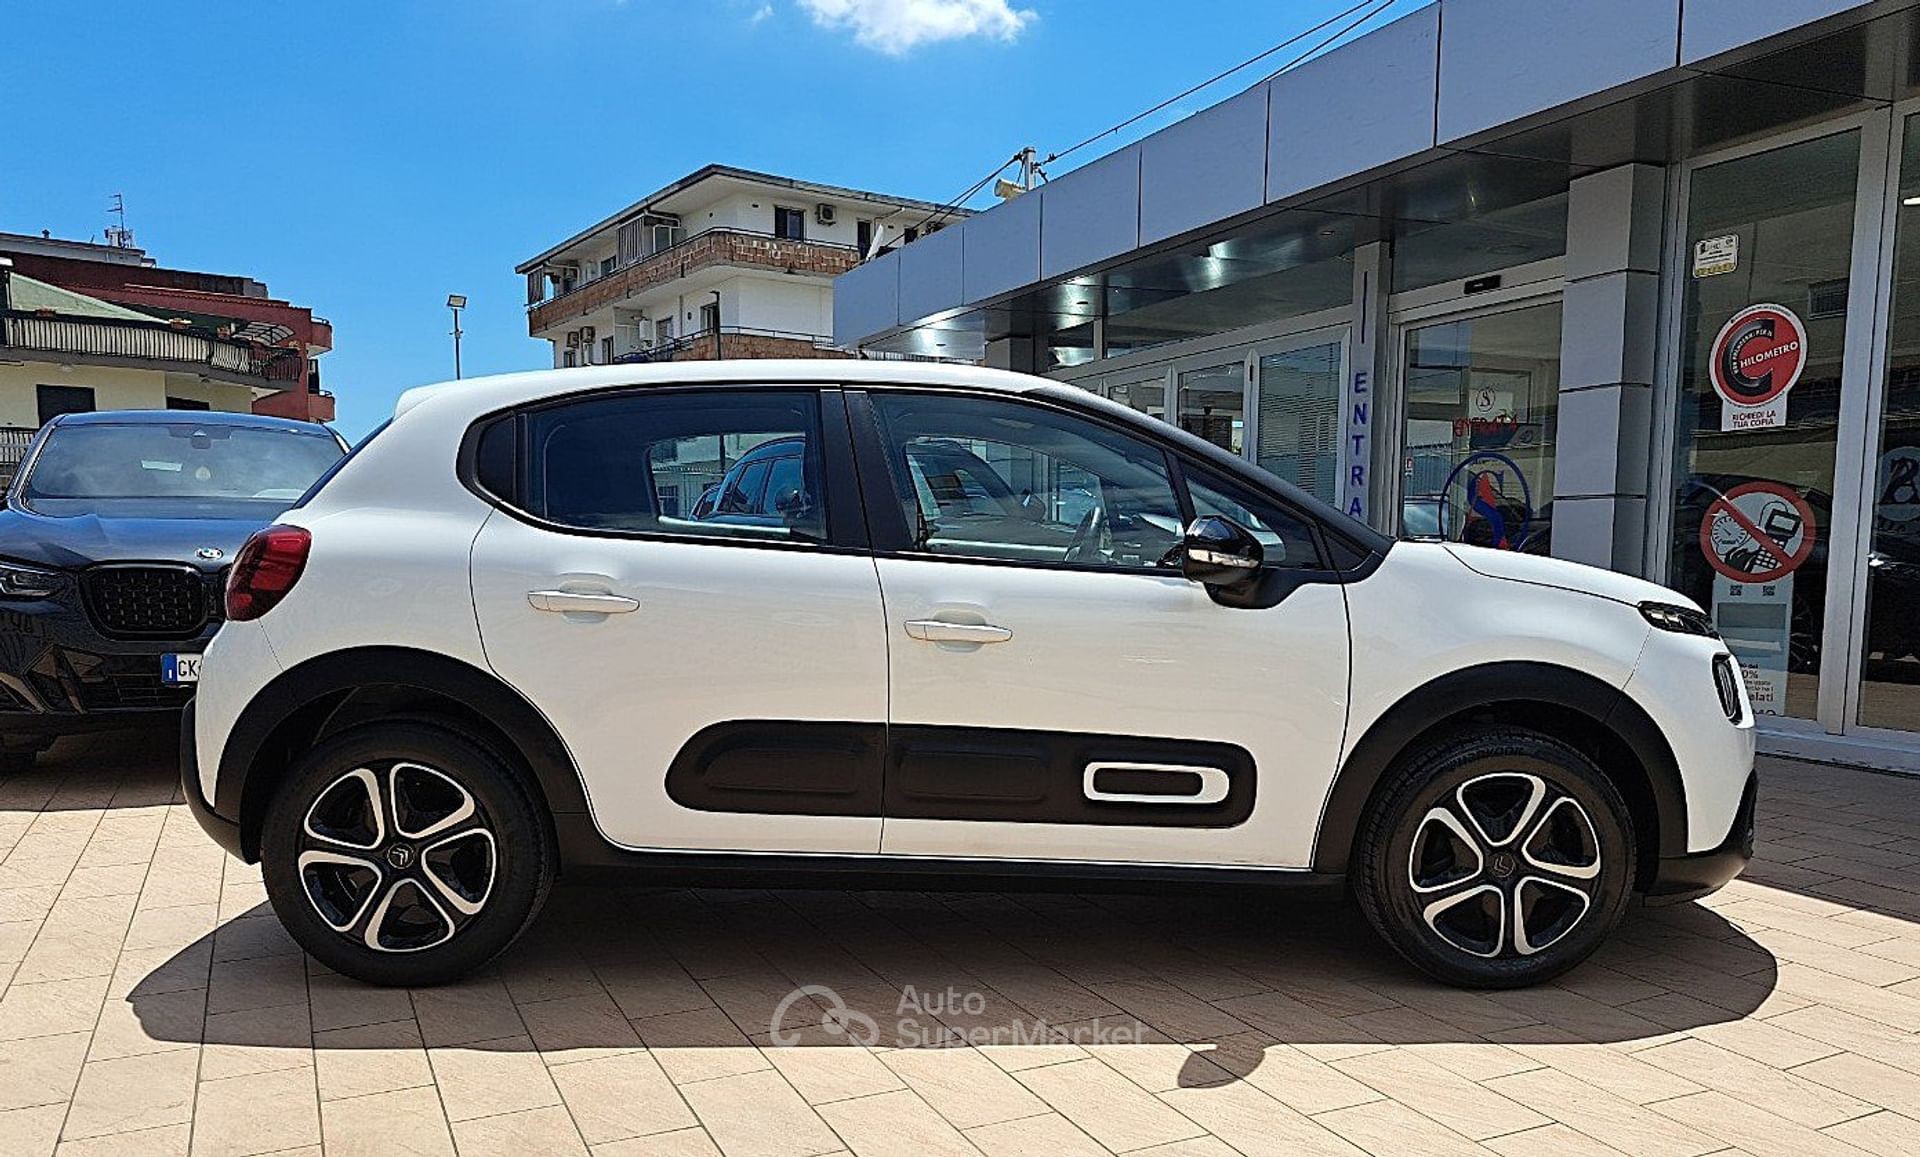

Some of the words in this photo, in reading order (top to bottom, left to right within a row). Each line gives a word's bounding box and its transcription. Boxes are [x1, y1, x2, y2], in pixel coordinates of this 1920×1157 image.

[1733, 420, 1749, 428] TUA
[1750, 418, 1775, 427] COPIA
[178, 659, 200, 677] GK
[1742, 669, 1759, 679] 0%
[1750, 691, 1774, 702] elati
